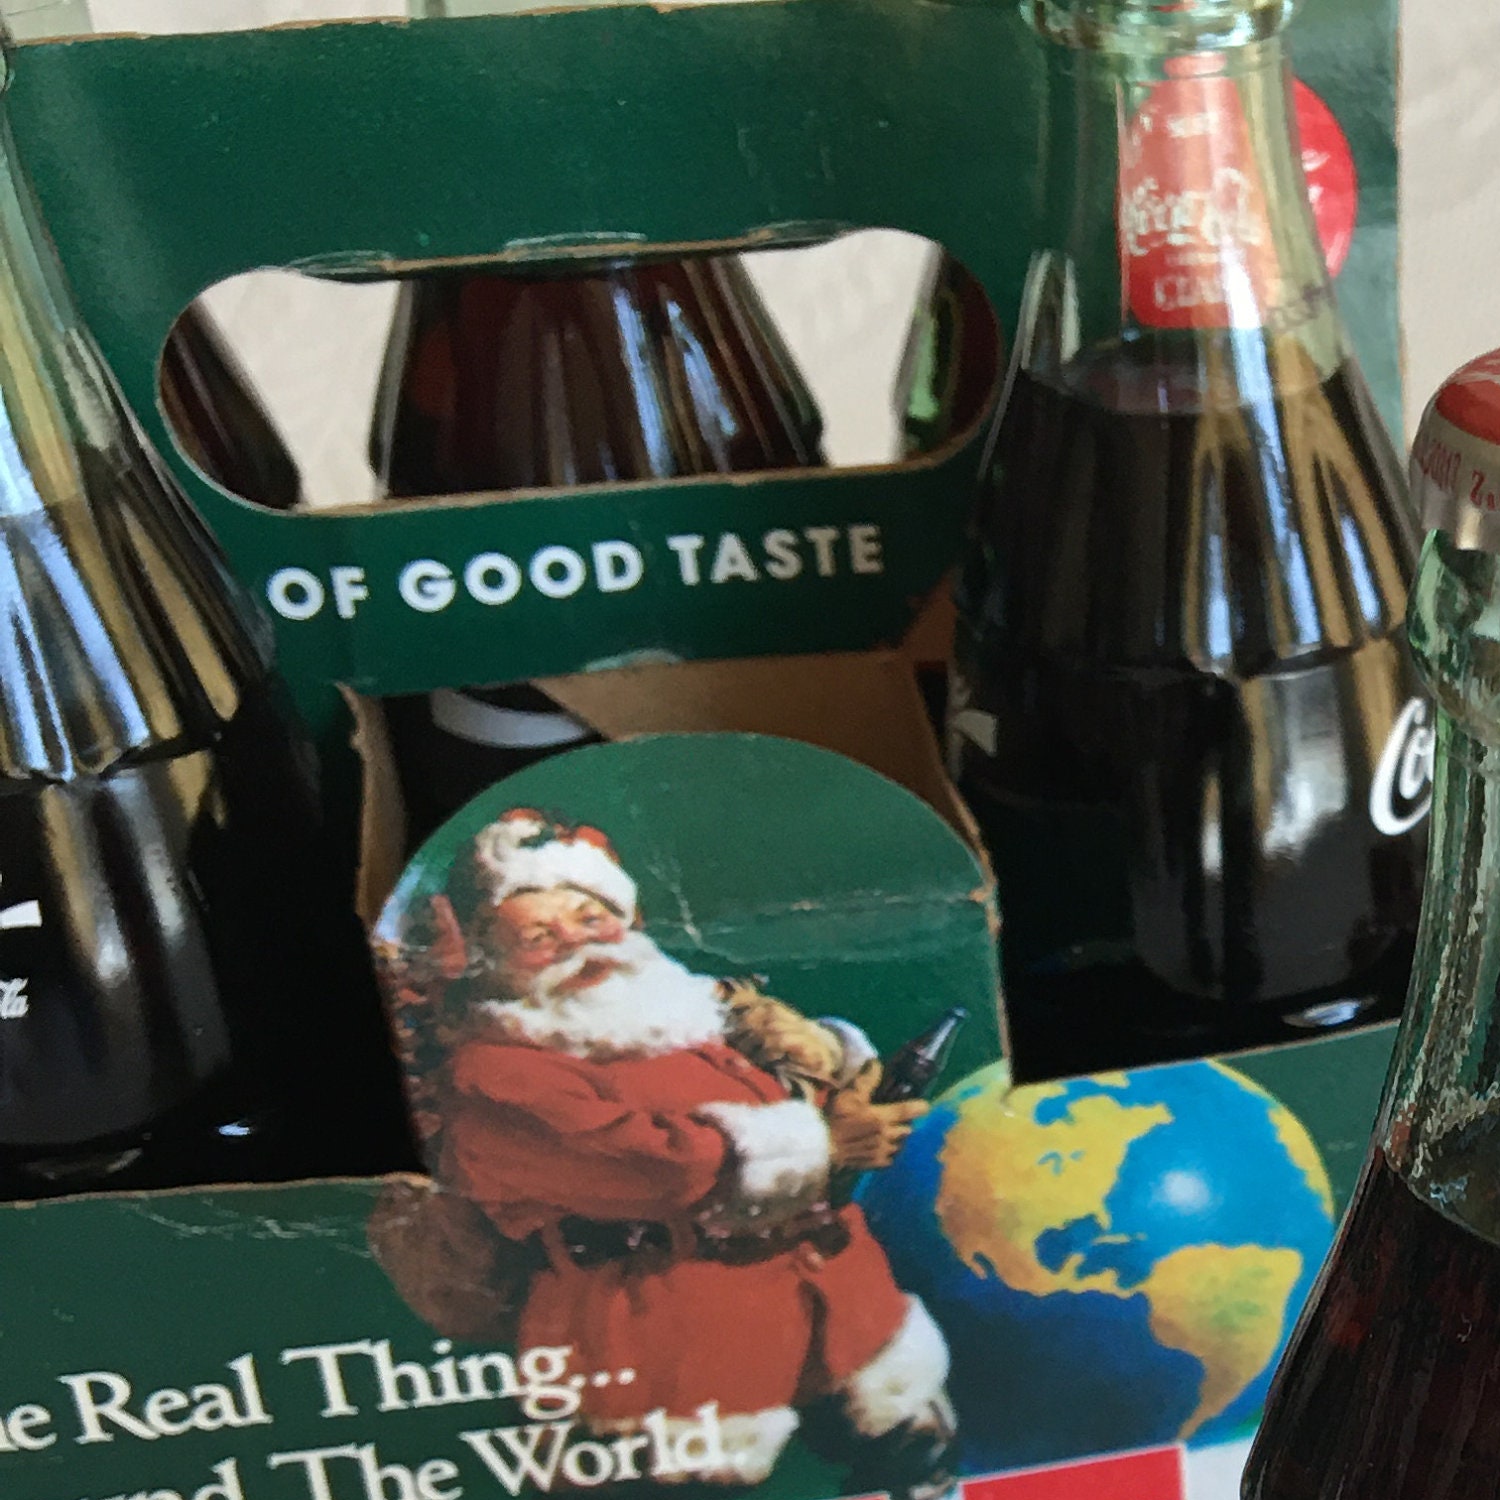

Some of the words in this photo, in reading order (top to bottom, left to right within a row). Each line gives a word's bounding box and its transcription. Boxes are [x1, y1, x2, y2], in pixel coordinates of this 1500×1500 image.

[265, 565, 370, 620] OF
[398, 539, 645, 613] GOOD
[666, 523, 884, 585] TASTE
[56, 1353, 274, 1445] Real
